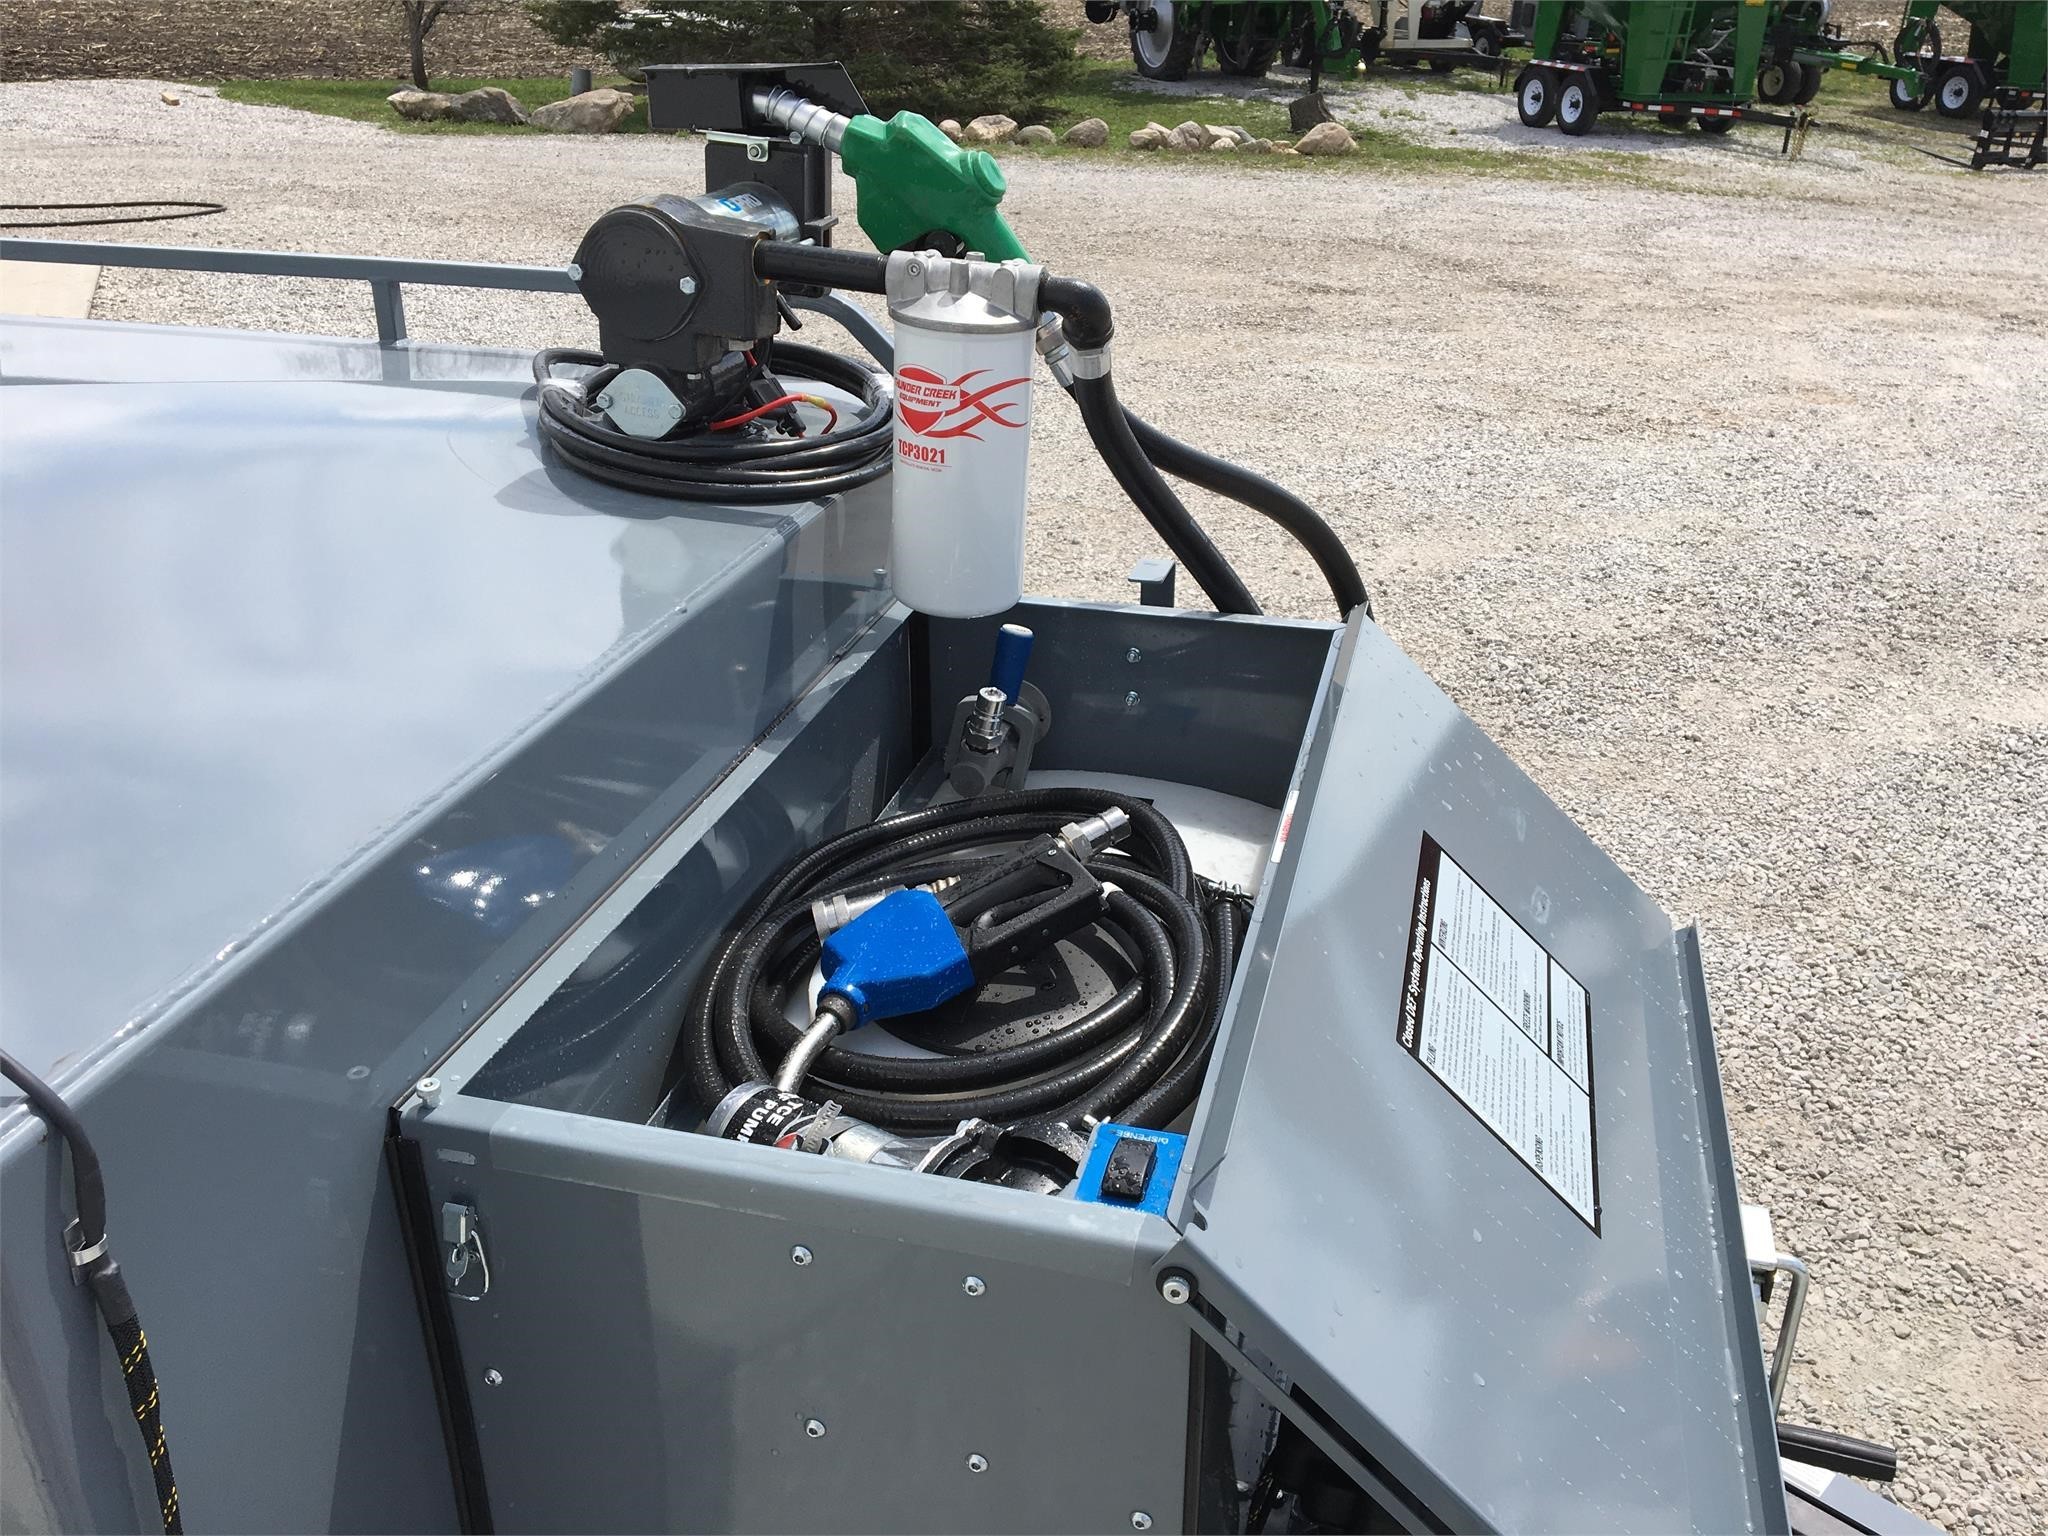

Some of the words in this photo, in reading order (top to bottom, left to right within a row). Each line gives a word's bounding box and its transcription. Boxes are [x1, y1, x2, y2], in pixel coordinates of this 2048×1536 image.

[899, 393, 942, 408] EQUIPMENT
[923, 387, 957, 400] CREEK
[898, 439, 945, 464] TCP3021
[1416, 877, 1431, 924] Instructions
[1412, 921, 1427, 963] Operating
[1408, 961, 1422, 997] System
[1406, 992, 1417, 1018] DEF
[1402, 1013, 1415, 1048] Closed
[1523, 1010, 1531, 1034] FREEZE
[1426, 1042, 1437, 1068] FILLING
[1116, 1129, 1170, 1145] DISPENSE
[1535, 1134, 1543, 1173] DISPENSING
